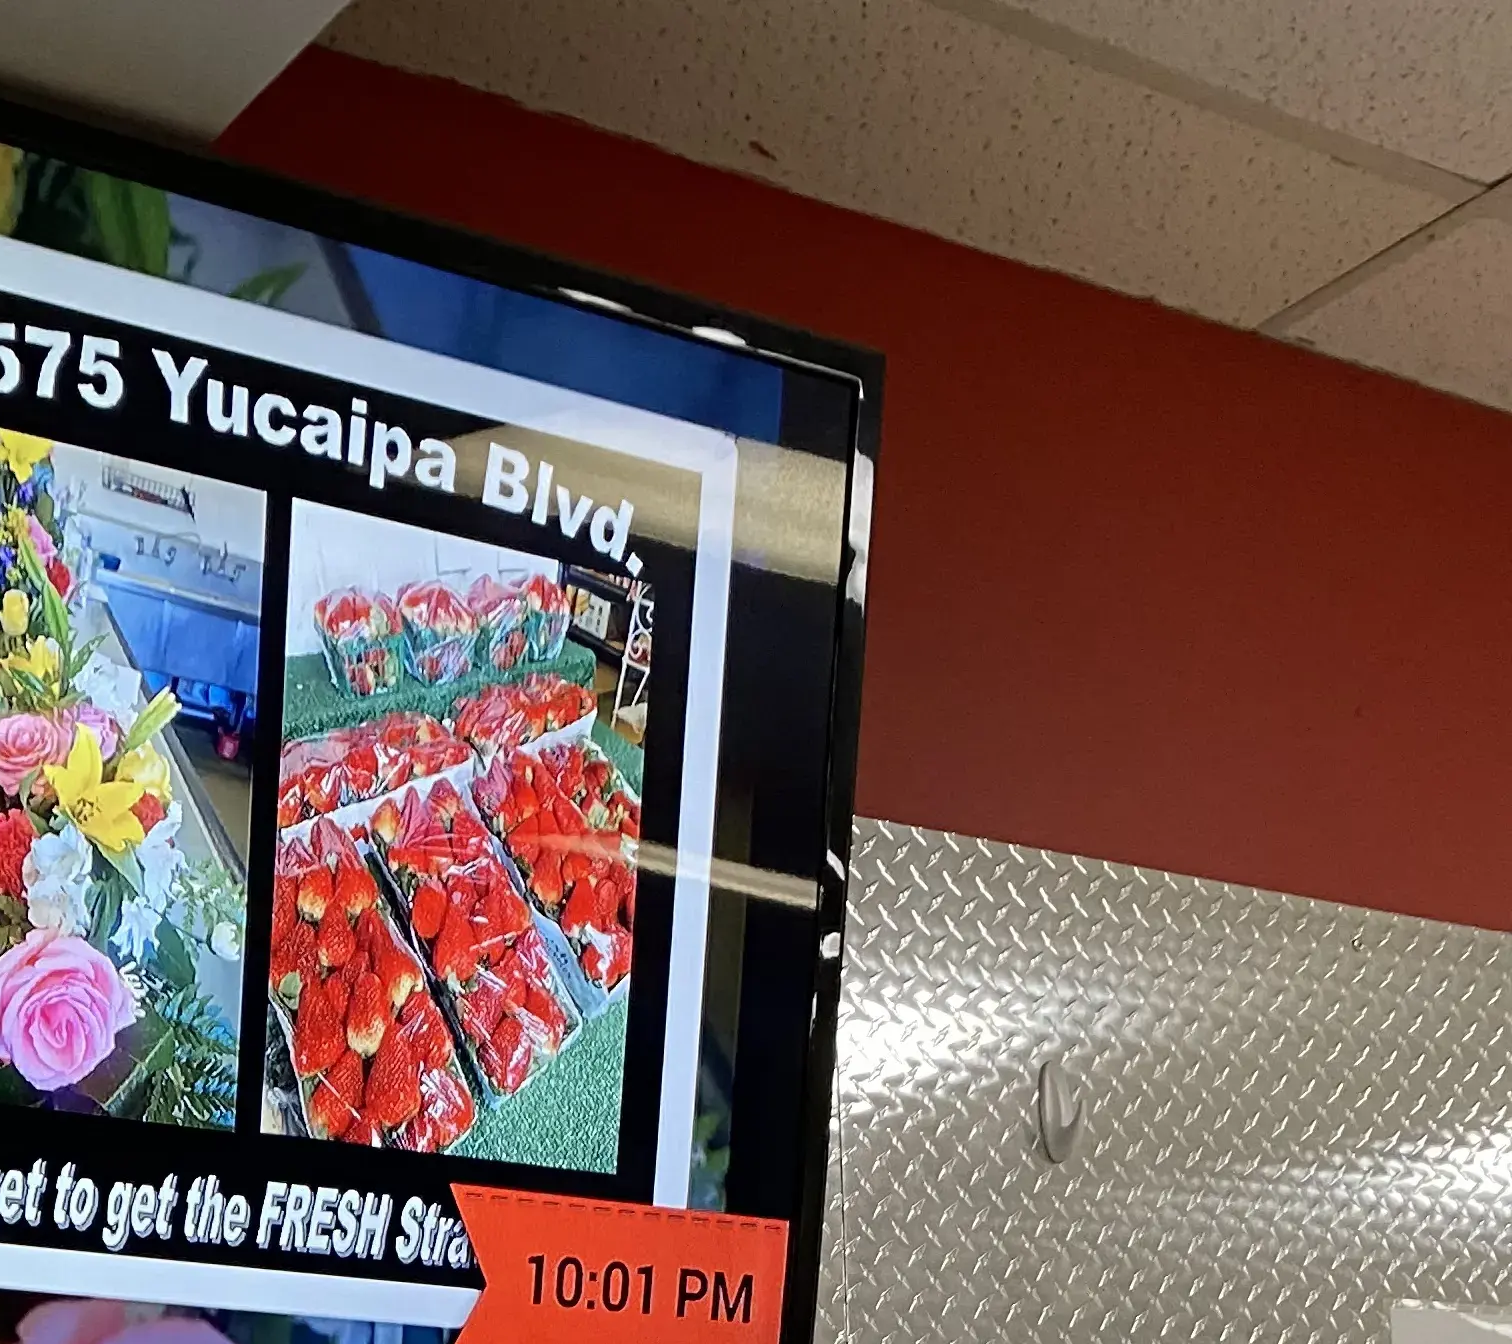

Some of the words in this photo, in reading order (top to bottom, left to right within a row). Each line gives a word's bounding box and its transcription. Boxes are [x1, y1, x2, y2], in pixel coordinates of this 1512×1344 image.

[151, 347, 456, 494] Yucaipa
[481, 443, 645, 574] Blvd.
[54, 1162, 99, 1232] to
[102, 1173, 178, 1252] get
[184, 1175, 251, 1247] the
[256, 1181, 393, 1260] FRESH
[527, 1254, 654, 1315] 10:01
[675, 1267, 754, 1324] PM
